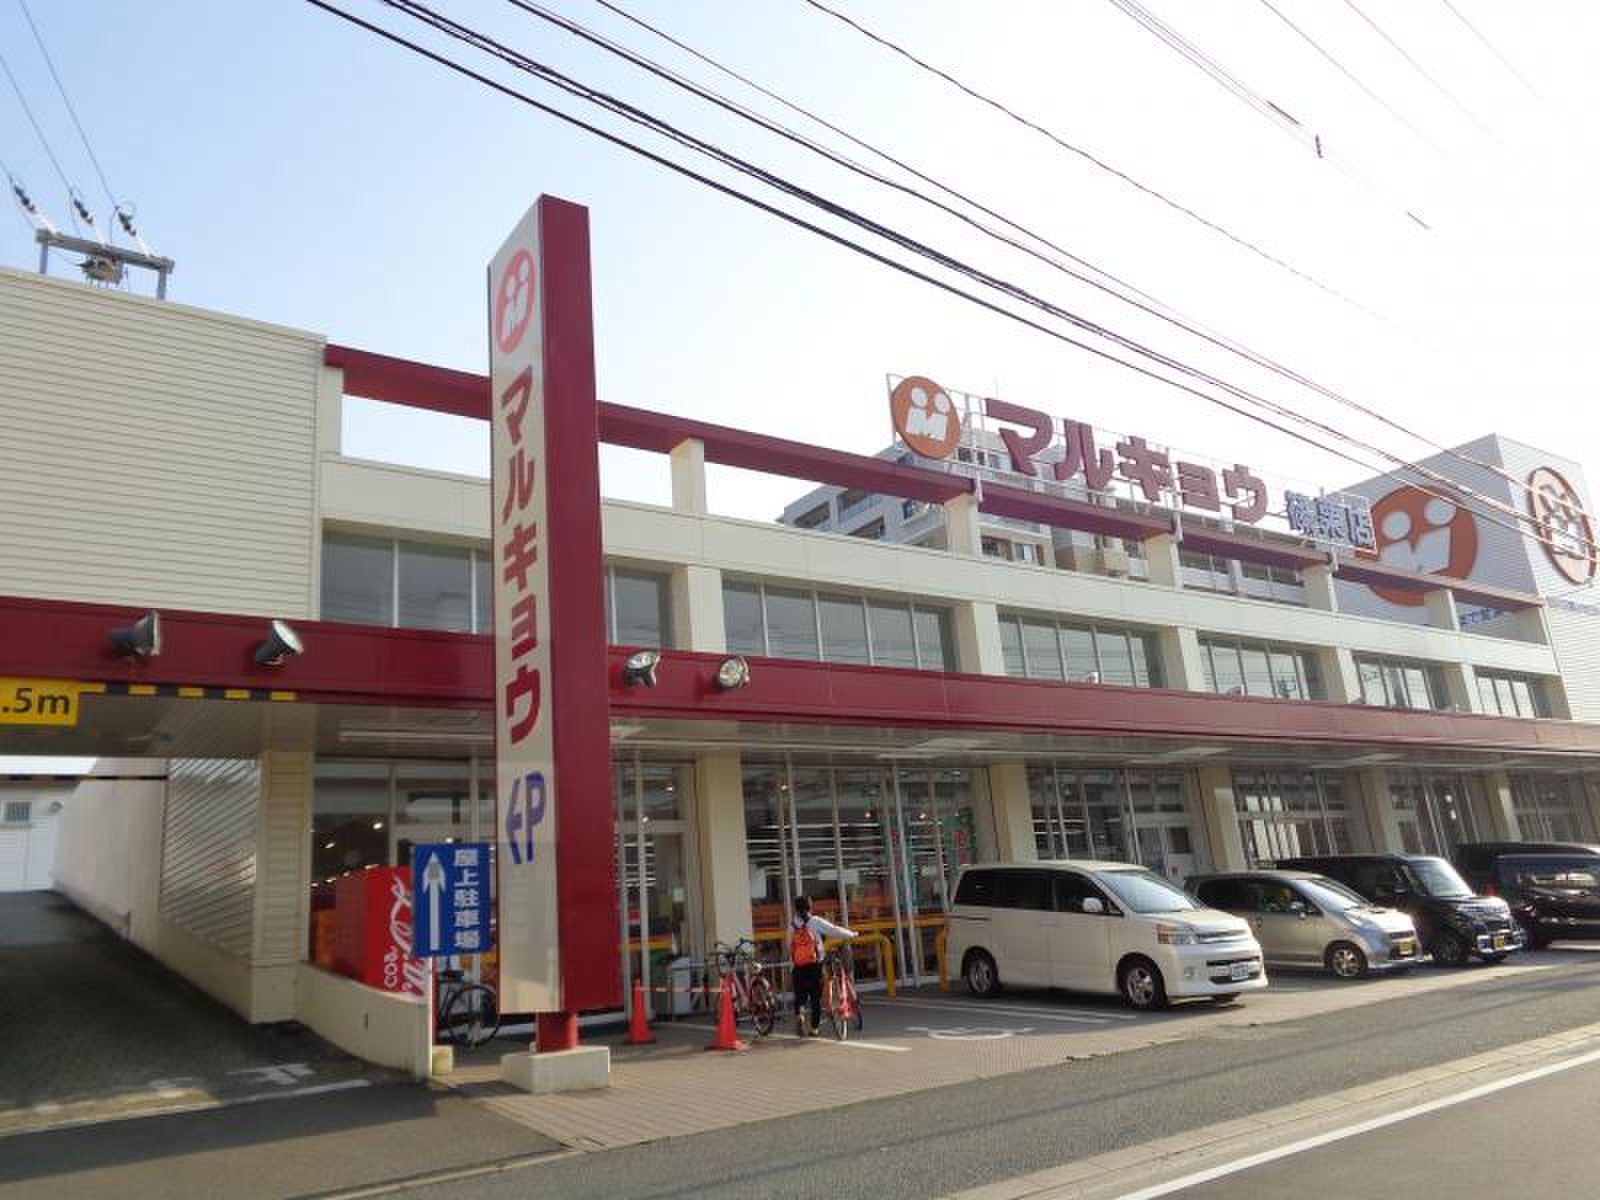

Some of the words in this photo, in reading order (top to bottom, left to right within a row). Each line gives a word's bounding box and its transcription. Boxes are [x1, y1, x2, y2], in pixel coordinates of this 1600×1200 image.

[985, 397, 1269, 525] マルキョウ
[502, 364, 541, 745] マルキョウ
[453, 849, 480, 948] 屋上駐車場
